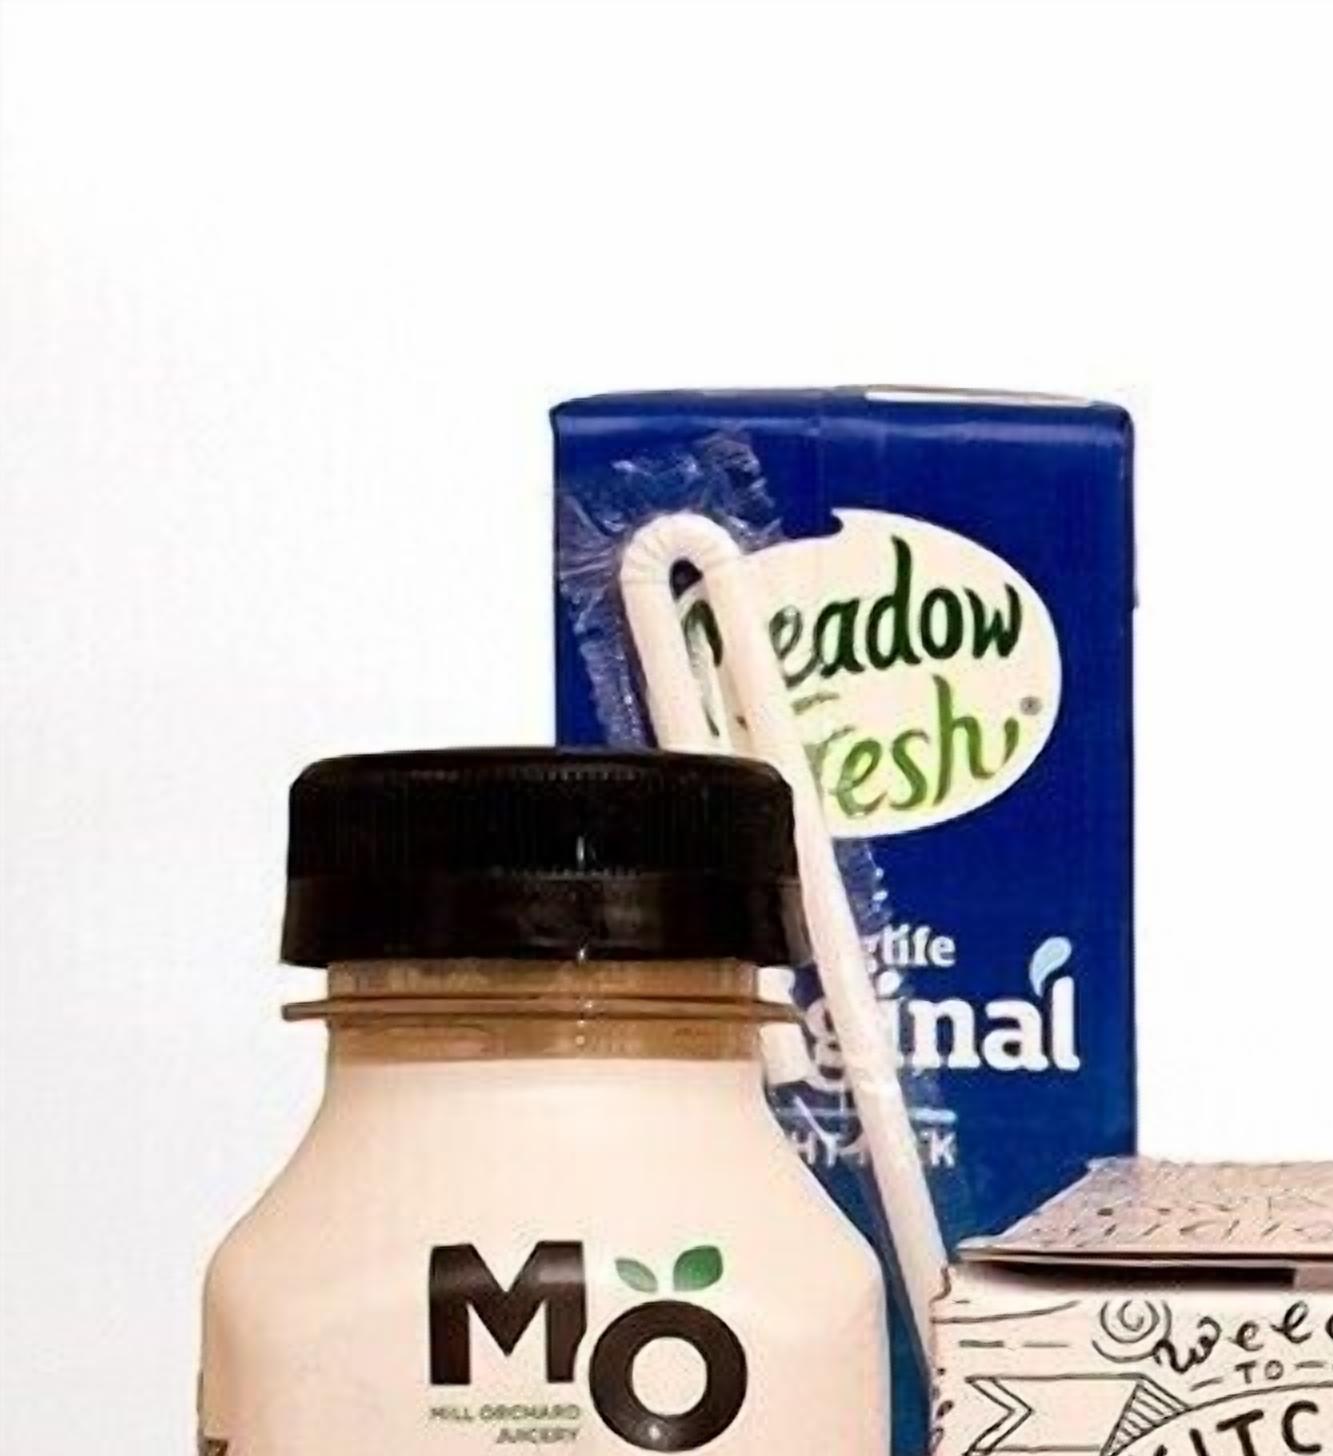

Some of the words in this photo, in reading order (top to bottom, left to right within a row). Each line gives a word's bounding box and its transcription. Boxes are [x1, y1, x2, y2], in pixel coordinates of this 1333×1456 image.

[683, 535, 1022, 690] eadow
[793, 673, 1020, 819] resh
[1234, 1358, 1285, 1384] TO
